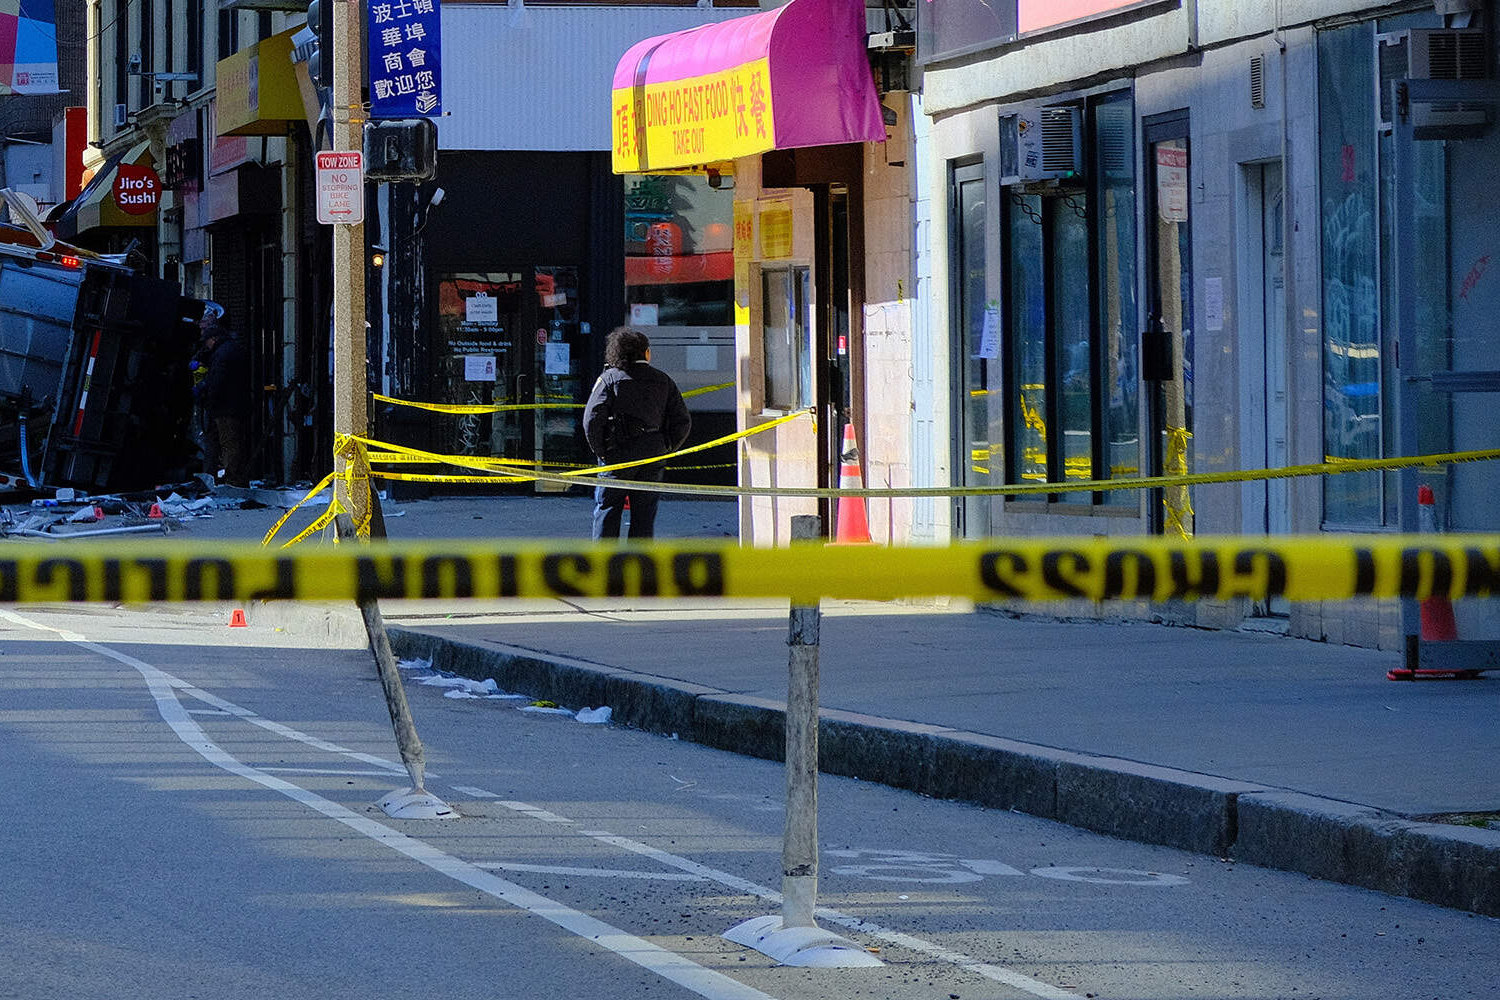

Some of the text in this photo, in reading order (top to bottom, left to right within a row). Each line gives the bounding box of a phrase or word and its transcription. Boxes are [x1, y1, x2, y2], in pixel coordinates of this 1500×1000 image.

[381, 22, 426, 47] 華埠
[382, 47, 426, 73] 商會
[374, 70, 436, 100] 歡迎您
[647, 91, 667, 127] DING
[669, 88, 681, 125] HO
[683, 85, 704, 122] FAST
[705, 80, 729, 120] FOOD
[731, 71, 766, 139] 快餐
[673, 127, 705, 155] TAKE OUT
[321, 156, 359, 168] TOW ZONE
[323, 184, 358, 192] STOPPING
[331, 174, 348, 183] NO
[119, 192, 156, 204] Sushi
[356, 554, 725, 598] BOSTON
[980, 550, 1287, 598] CROSS
